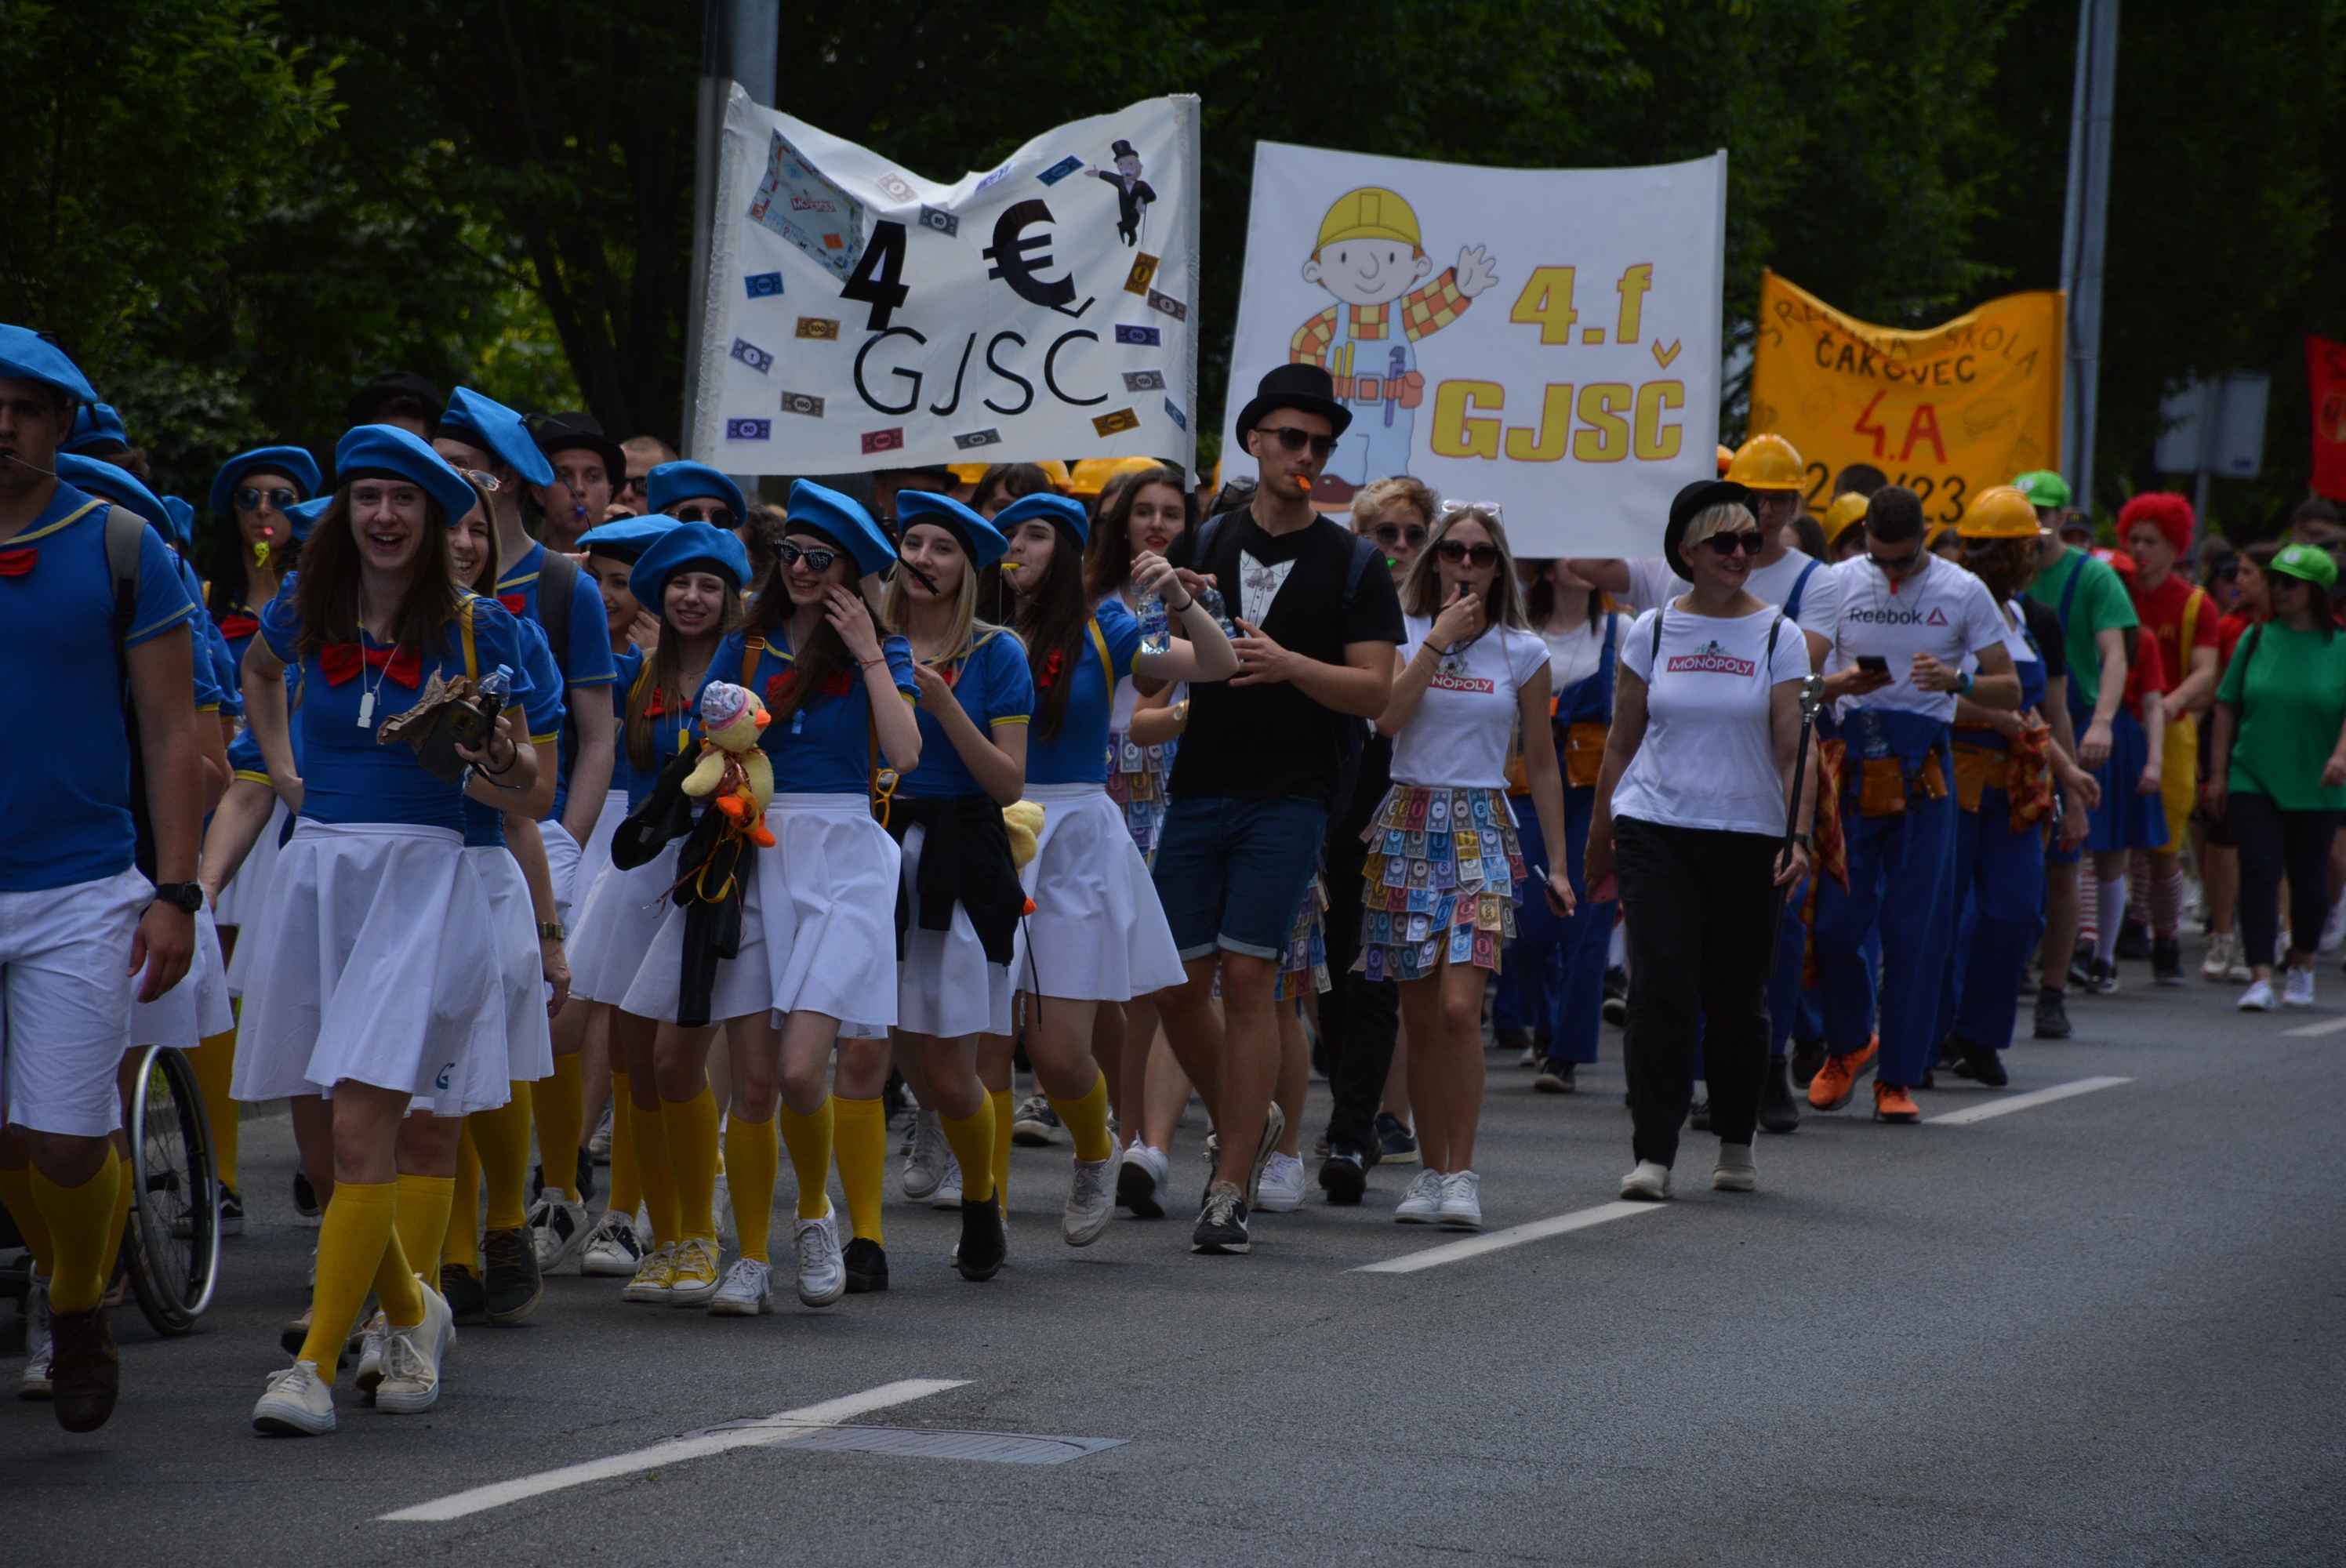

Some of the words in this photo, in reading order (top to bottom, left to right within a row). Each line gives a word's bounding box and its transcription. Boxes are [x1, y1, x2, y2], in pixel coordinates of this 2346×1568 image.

[839, 220, 910, 331] 4
[982, 198, 1077, 309] €
[1510, 263, 1653, 345] 4.f
[1815, 329, 1977, 387] ČAKOVEC
[1430, 339, 1685, 463] GJSČ
[1850, 608, 1923, 625] Reebok
[1431, 675, 1492, 691] NOPOLY
[1670, 657, 1752, 675] MONOPOLY
